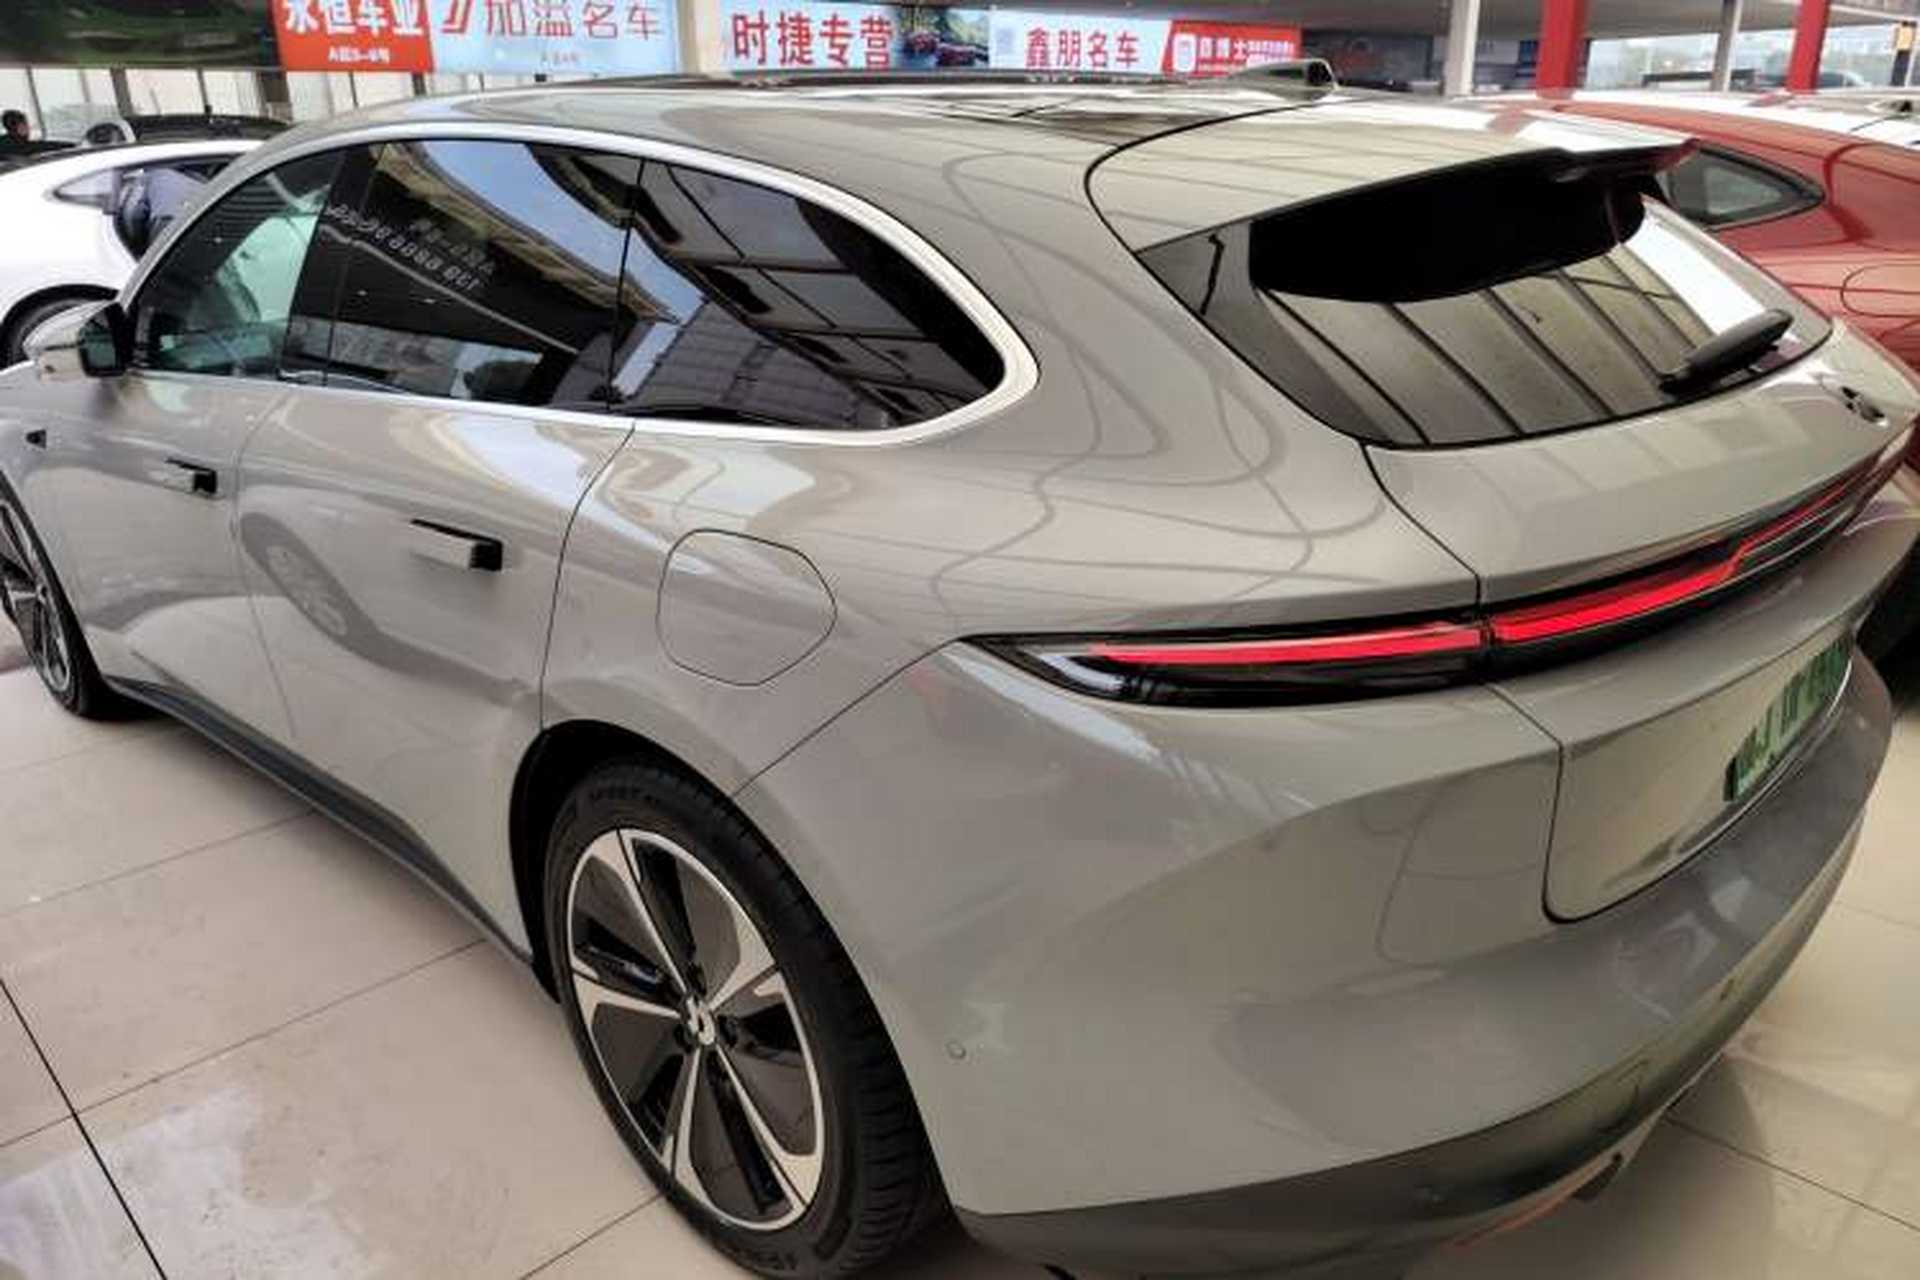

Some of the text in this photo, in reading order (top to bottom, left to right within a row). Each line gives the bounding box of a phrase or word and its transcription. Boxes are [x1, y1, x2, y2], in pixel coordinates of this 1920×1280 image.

[731, 11, 893, 72] 时捷专营
[1023, 26, 1140, 69] 鑫朋名车
